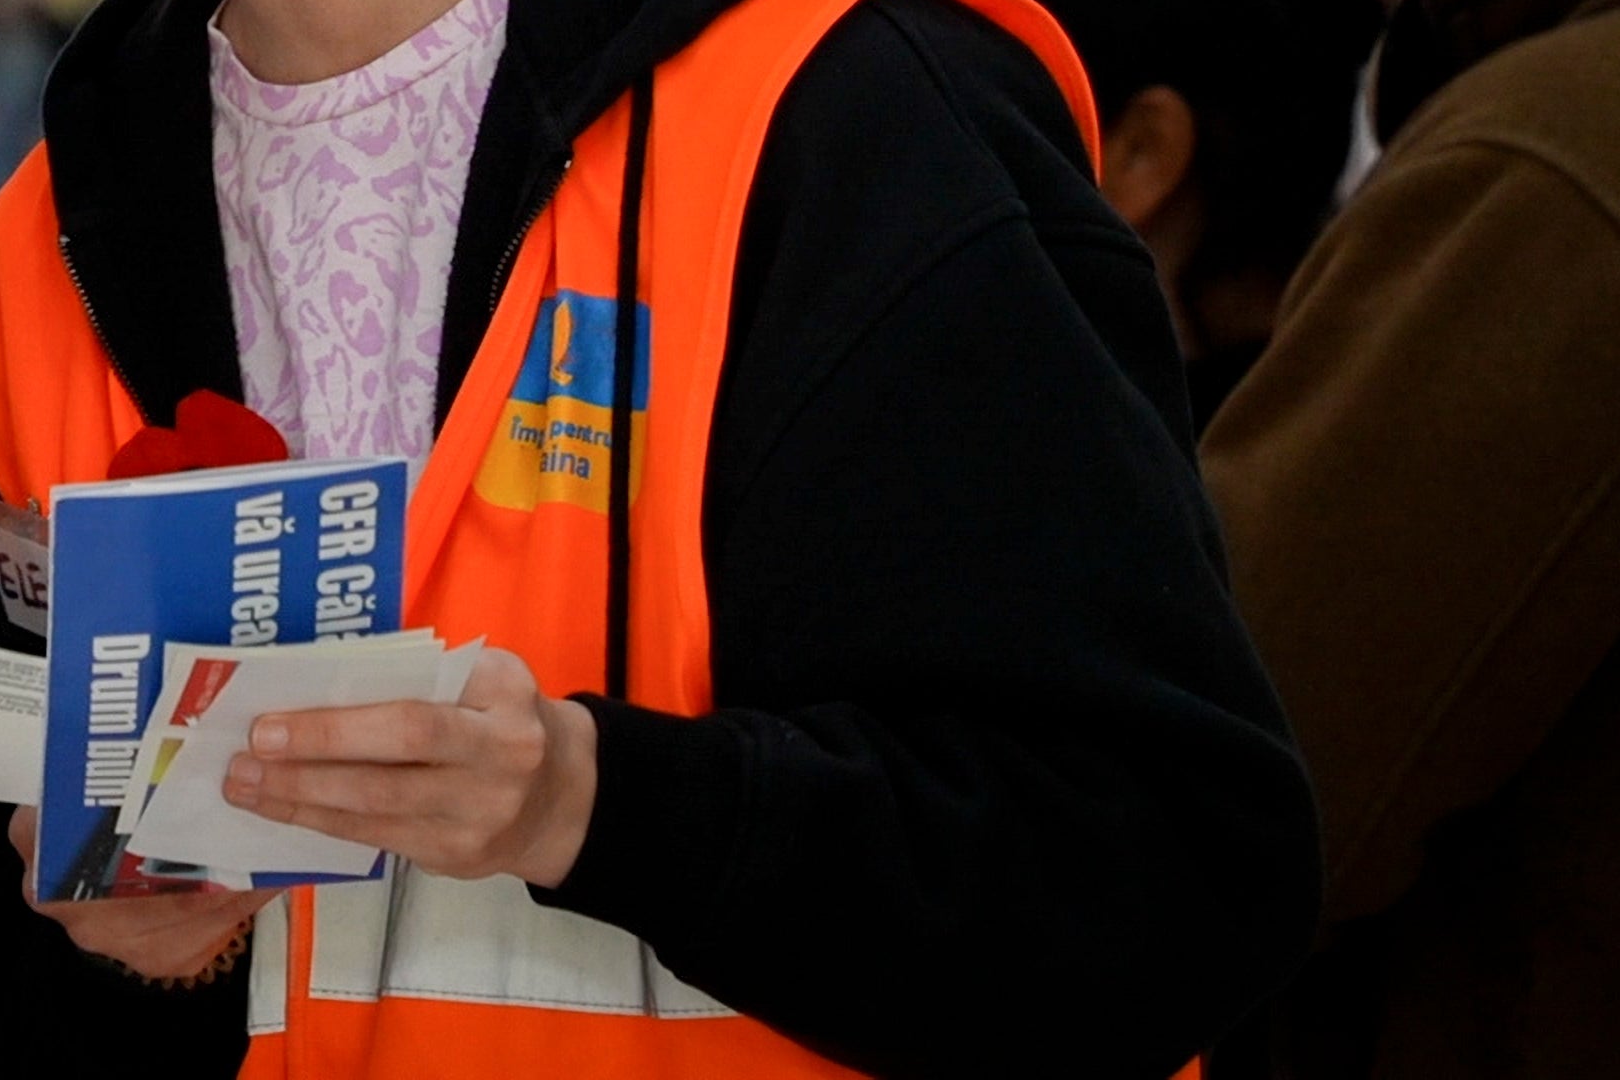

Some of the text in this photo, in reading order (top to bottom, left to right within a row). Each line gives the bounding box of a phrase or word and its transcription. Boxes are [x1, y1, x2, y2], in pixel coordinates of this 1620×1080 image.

[230, 491, 296, 648] vă urea
[318, 481, 380, 560] CFR
[88, 633, 151, 734] Drum
